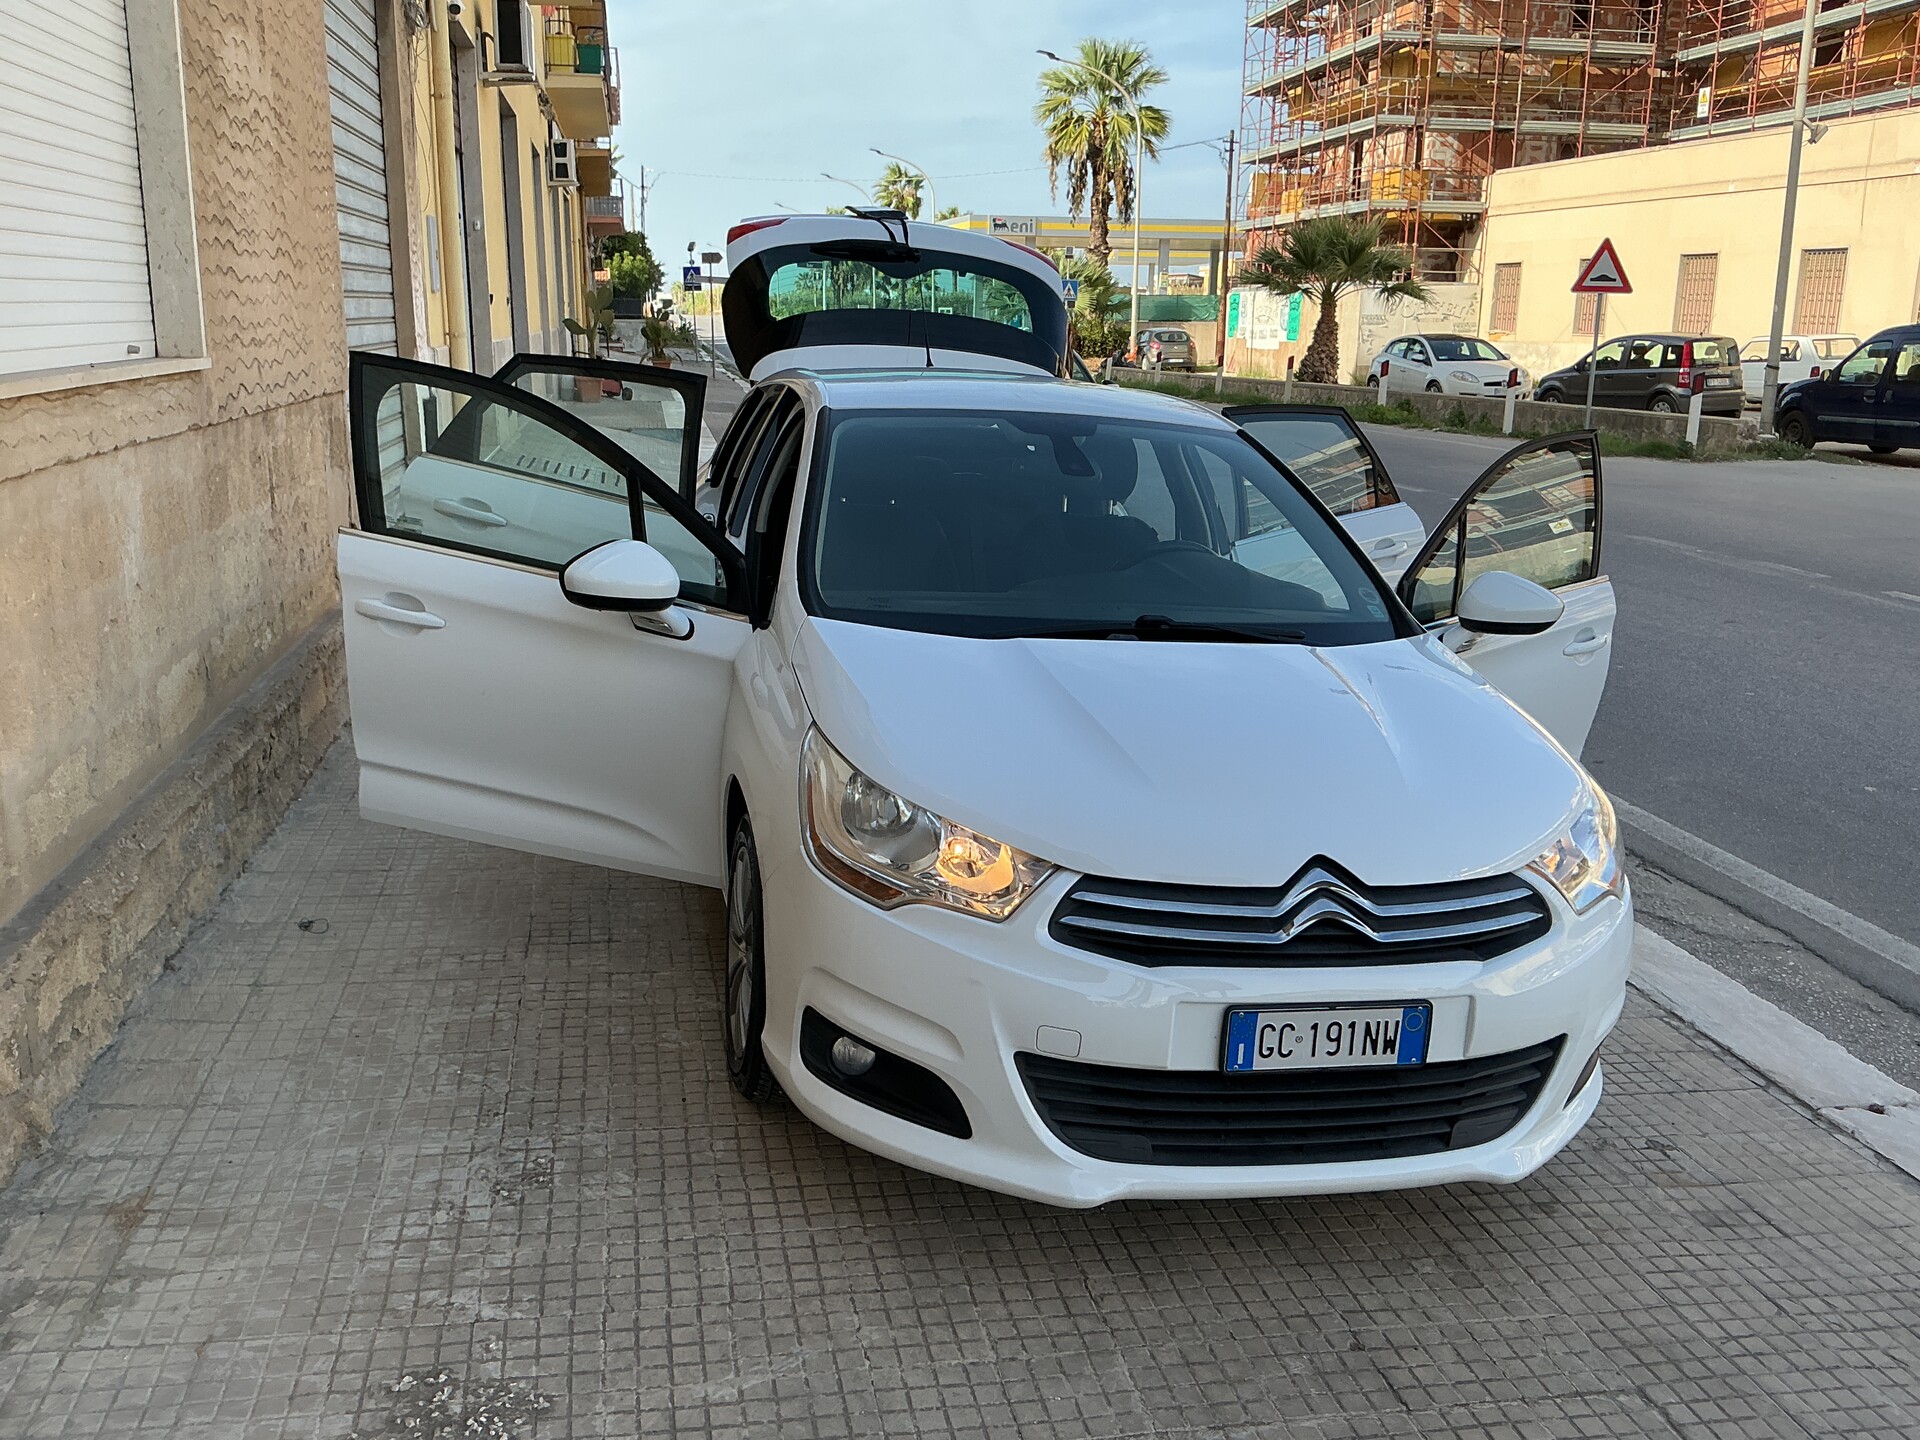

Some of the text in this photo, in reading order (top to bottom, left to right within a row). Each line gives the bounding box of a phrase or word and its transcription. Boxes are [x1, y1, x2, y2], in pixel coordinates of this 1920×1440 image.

[1011, 219, 1033, 233] eni
[1258, 1023, 1296, 1059] GC
[1310, 1019, 1400, 1058] 191NW
